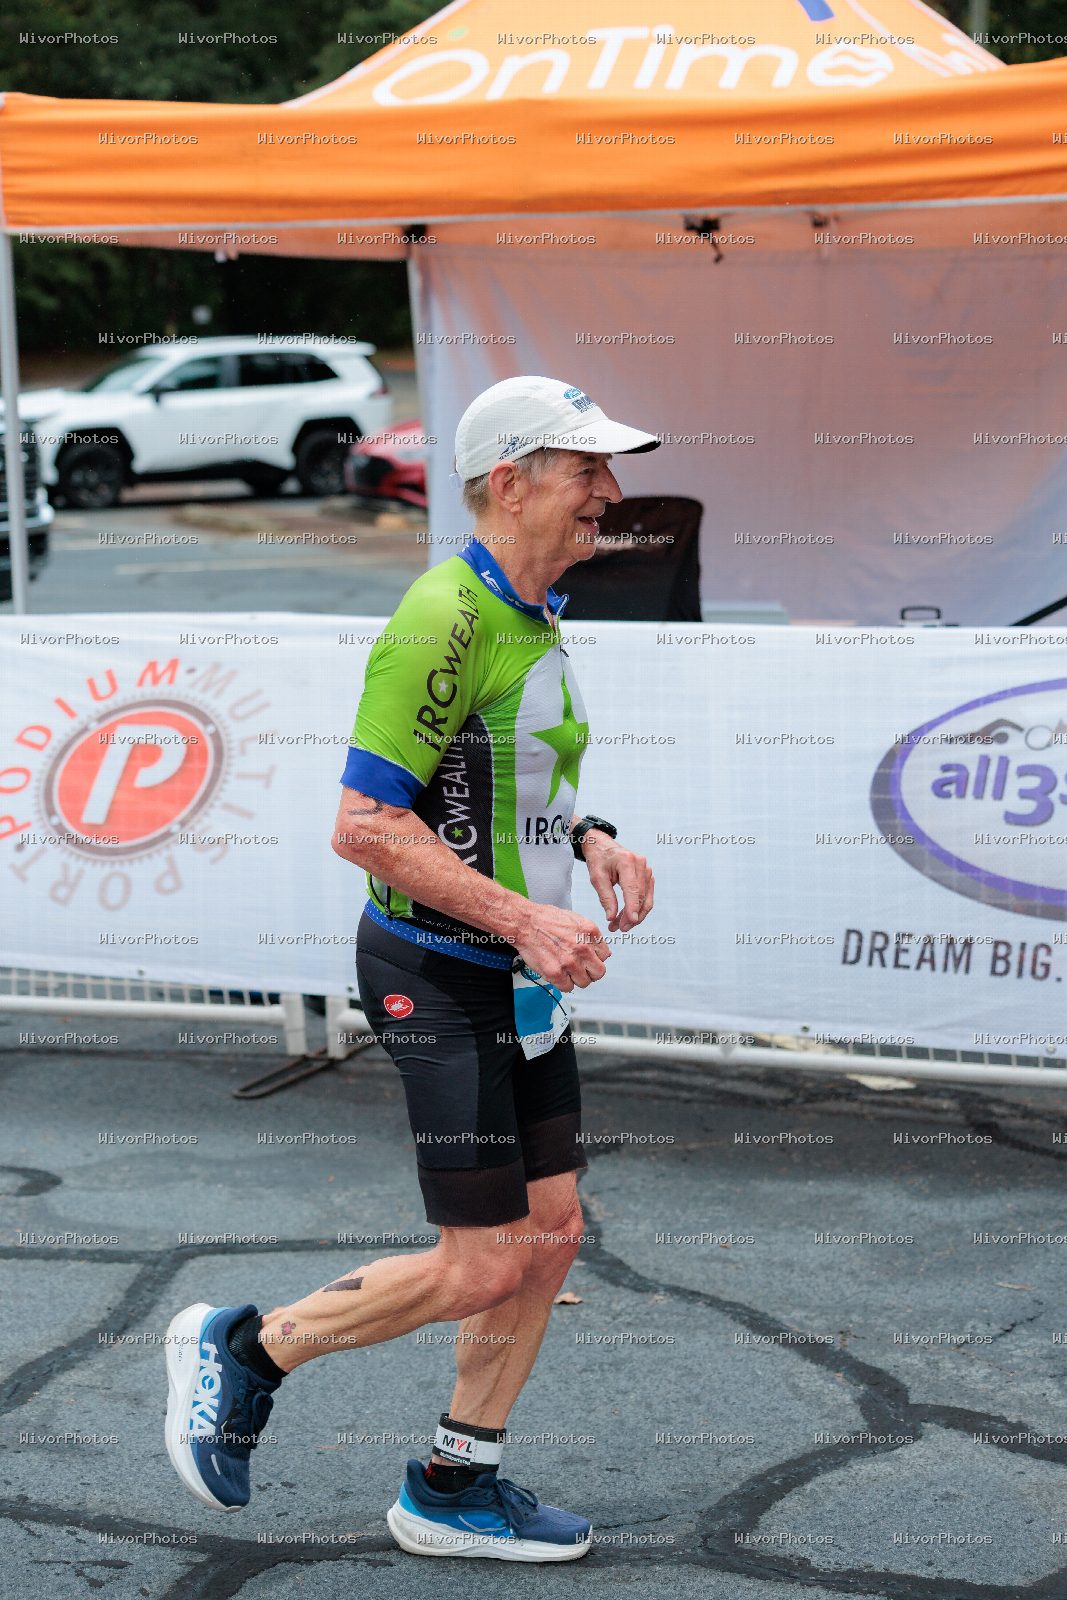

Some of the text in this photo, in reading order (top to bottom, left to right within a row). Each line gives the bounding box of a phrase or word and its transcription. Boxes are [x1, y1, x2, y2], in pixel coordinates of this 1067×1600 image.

[80, 723, 189, 825] P
[841, 928, 1063, 983] DREAM BIG.
[190, 1341, 223, 1436] HOKA
